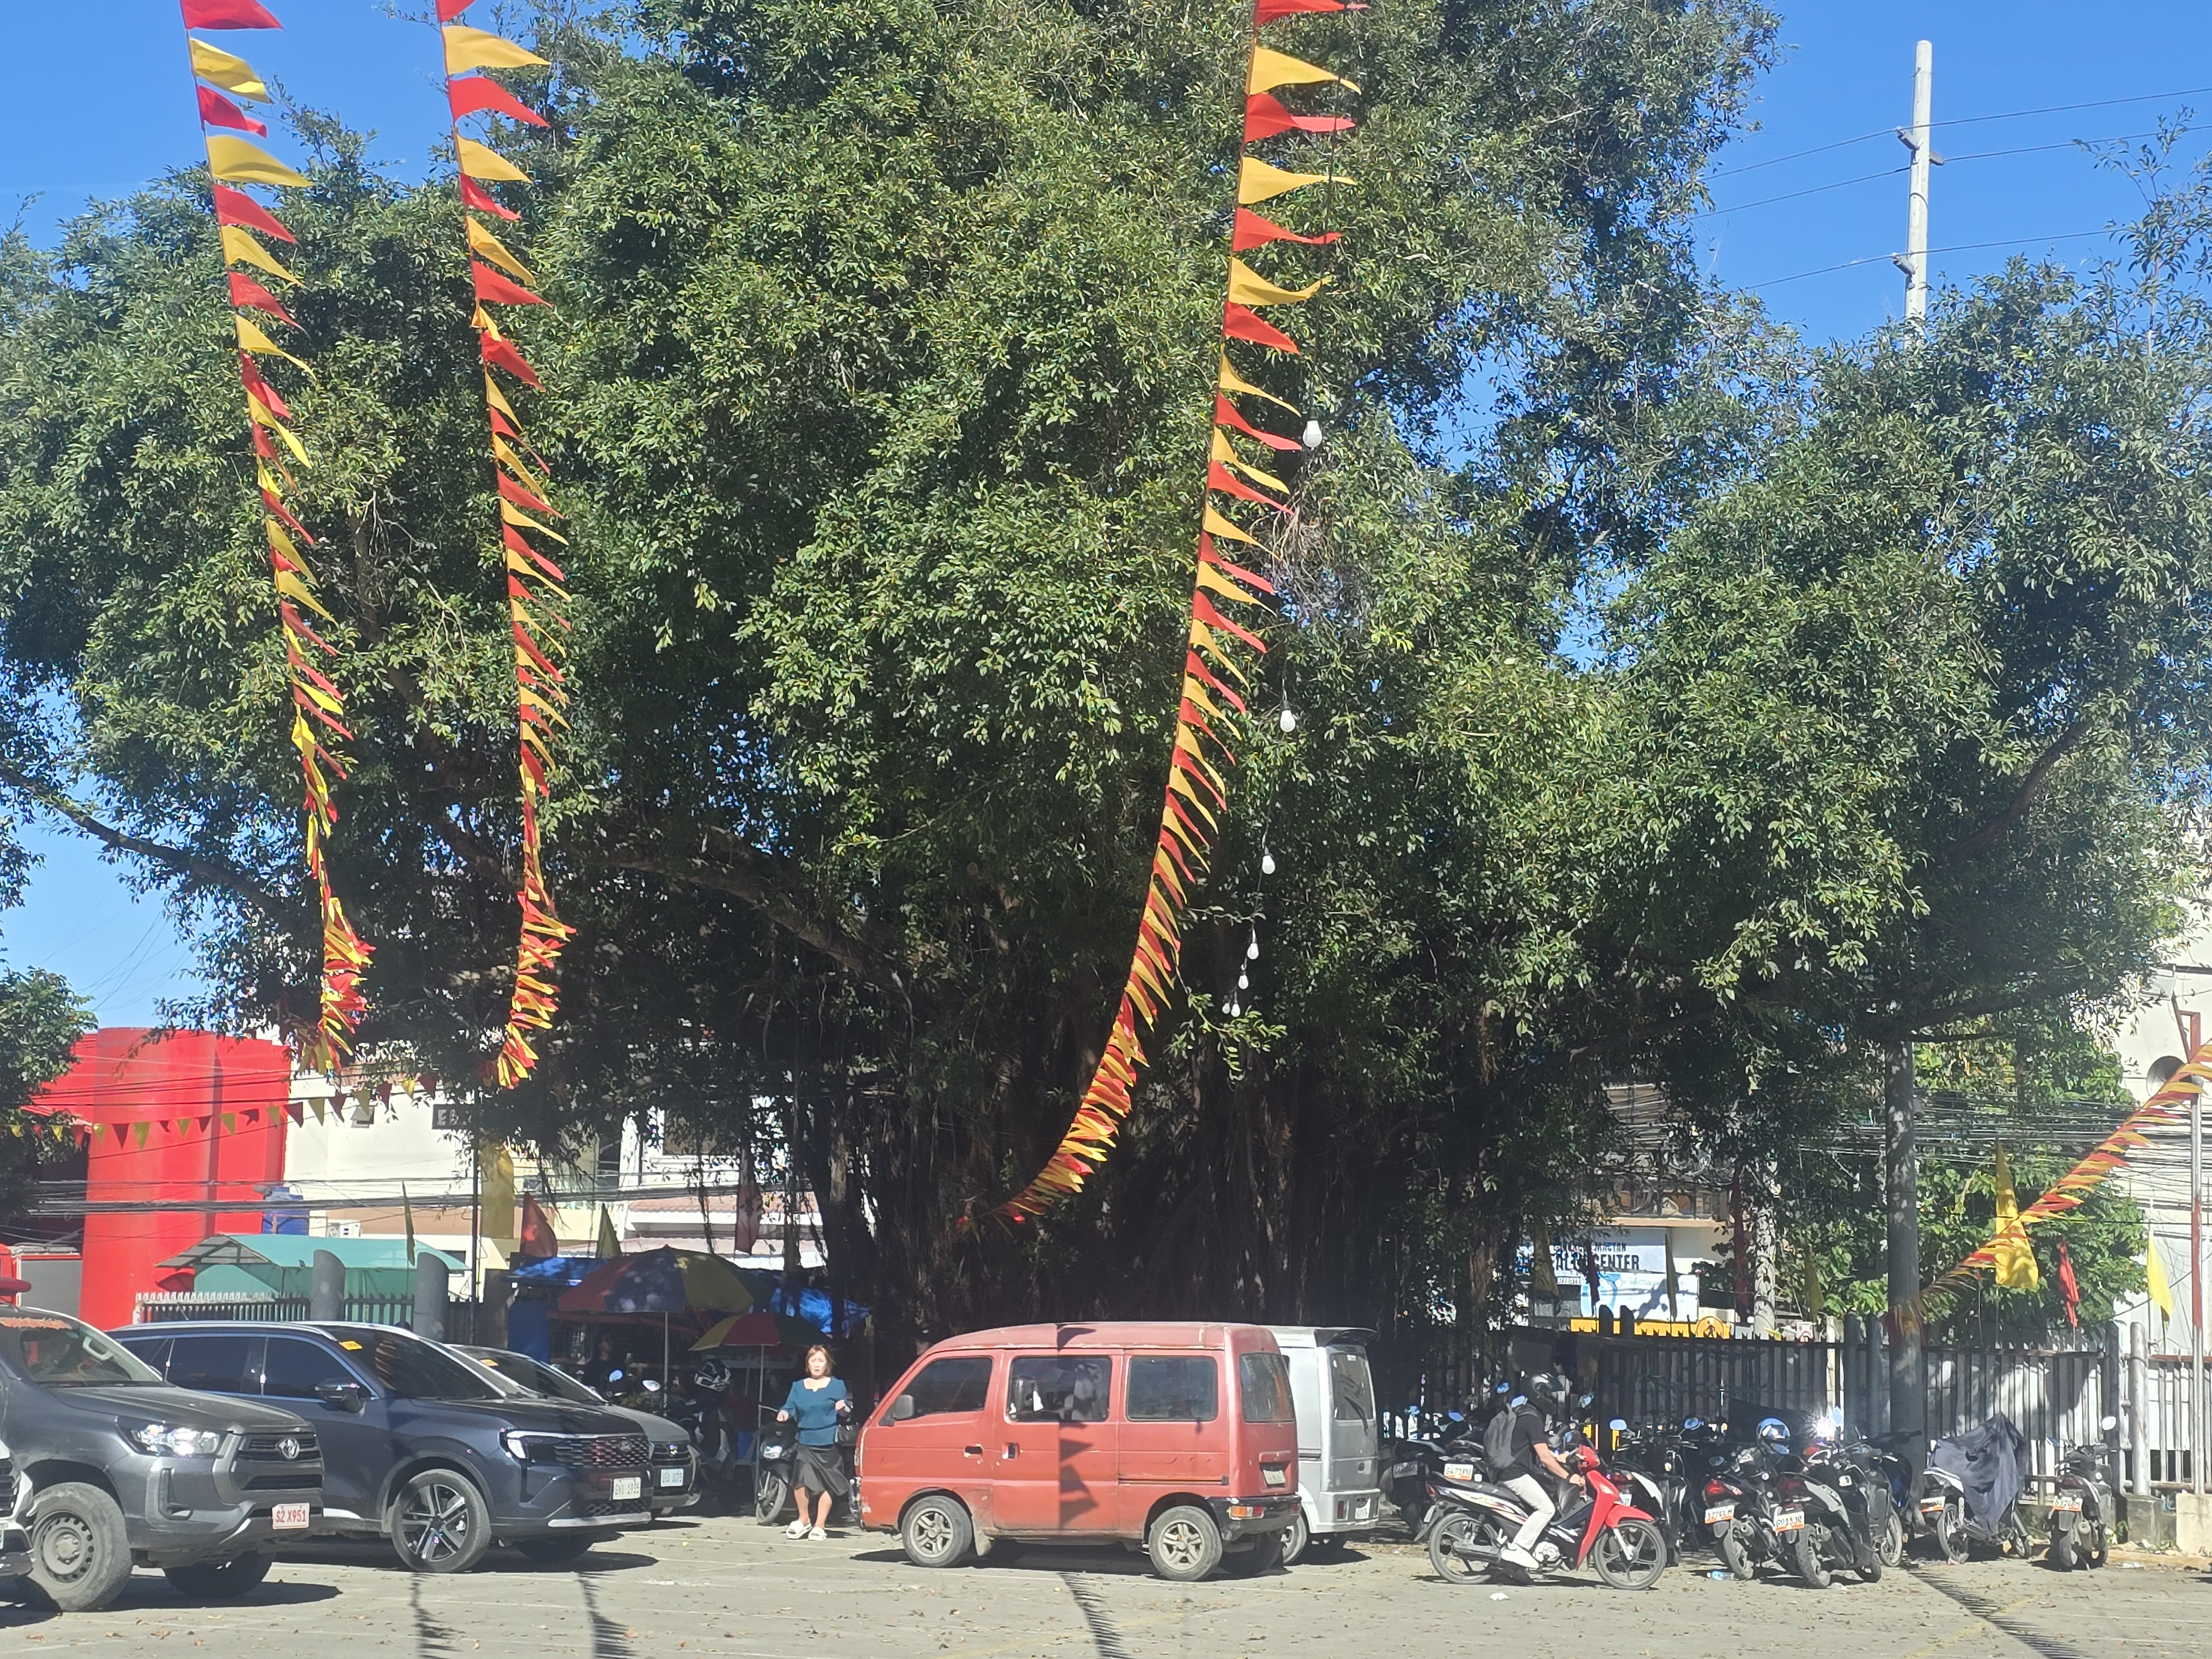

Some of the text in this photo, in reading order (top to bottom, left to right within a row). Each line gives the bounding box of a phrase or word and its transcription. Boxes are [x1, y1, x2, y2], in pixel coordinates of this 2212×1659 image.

[1593, 1254, 1639, 1270] CENTER
[275, 1510, 306, 1523] S2 X951
